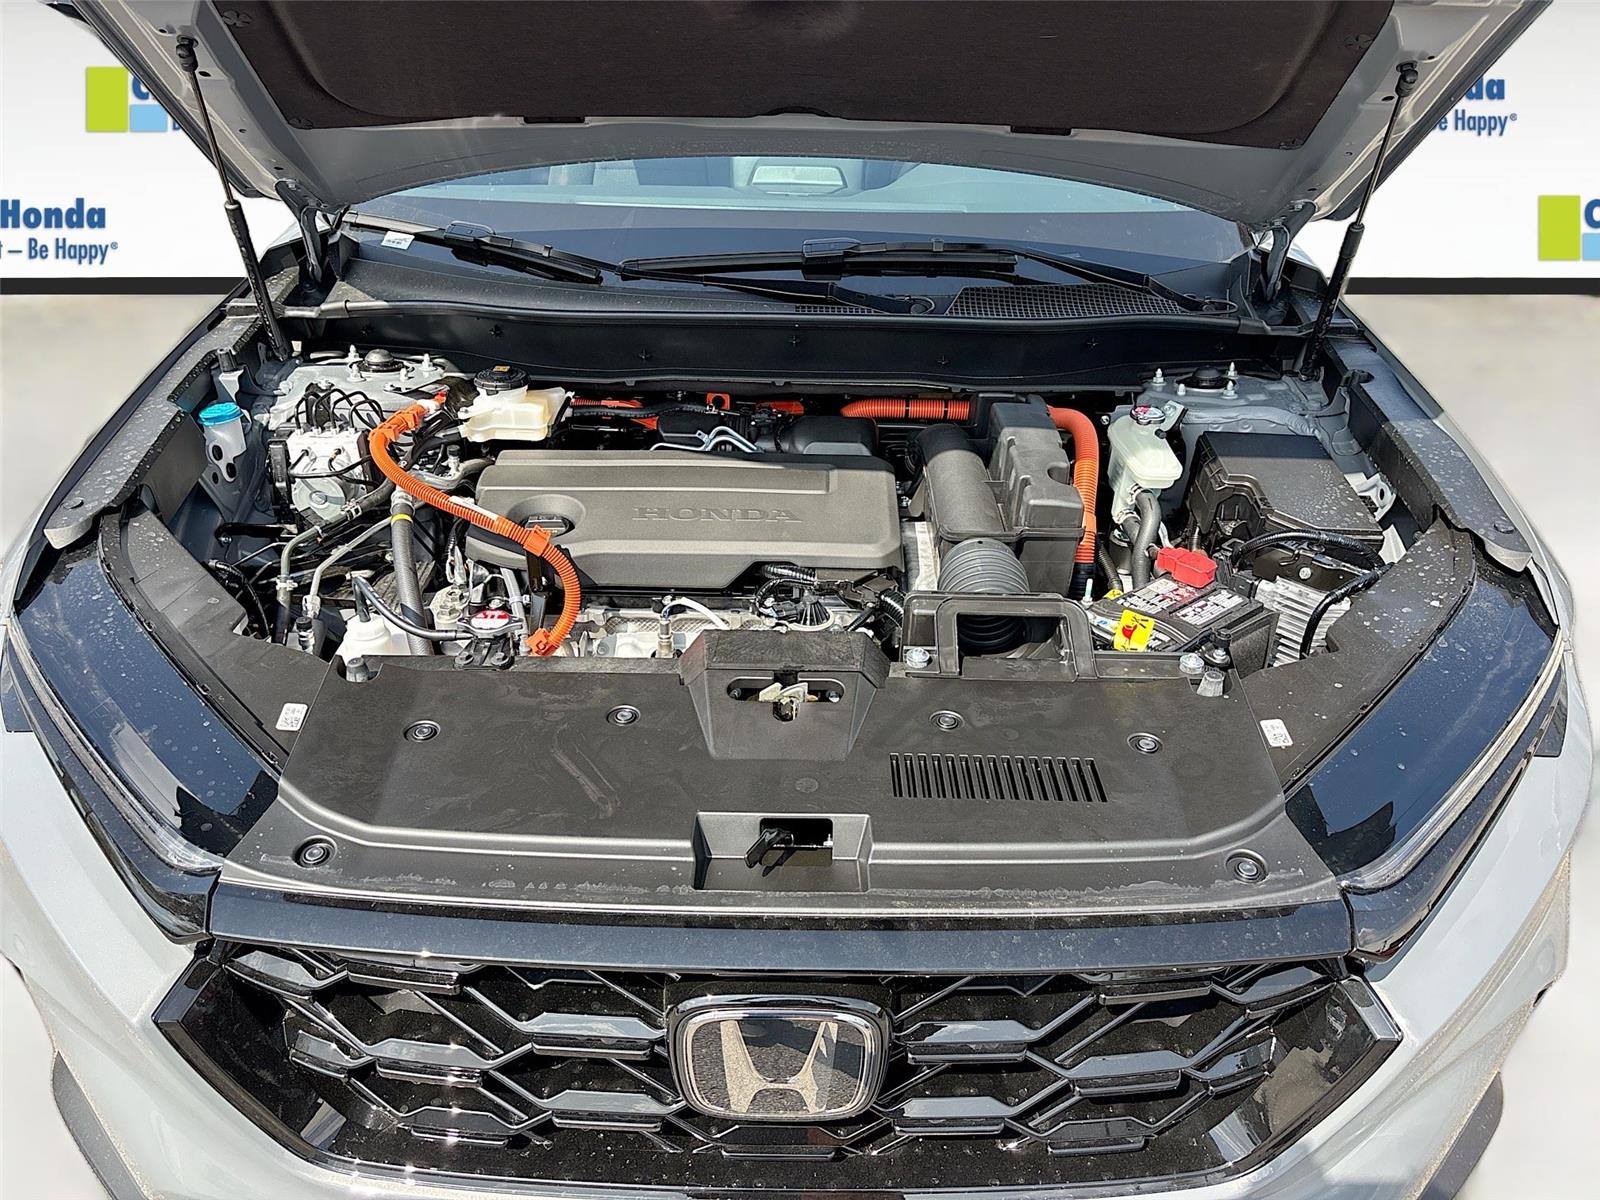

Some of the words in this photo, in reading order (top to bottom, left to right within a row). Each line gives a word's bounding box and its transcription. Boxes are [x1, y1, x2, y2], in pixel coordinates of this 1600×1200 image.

[0, 197, 106, 229] Honda
[28, 237, 49, 260] Be
[631, 505, 803, 524] HONDA
